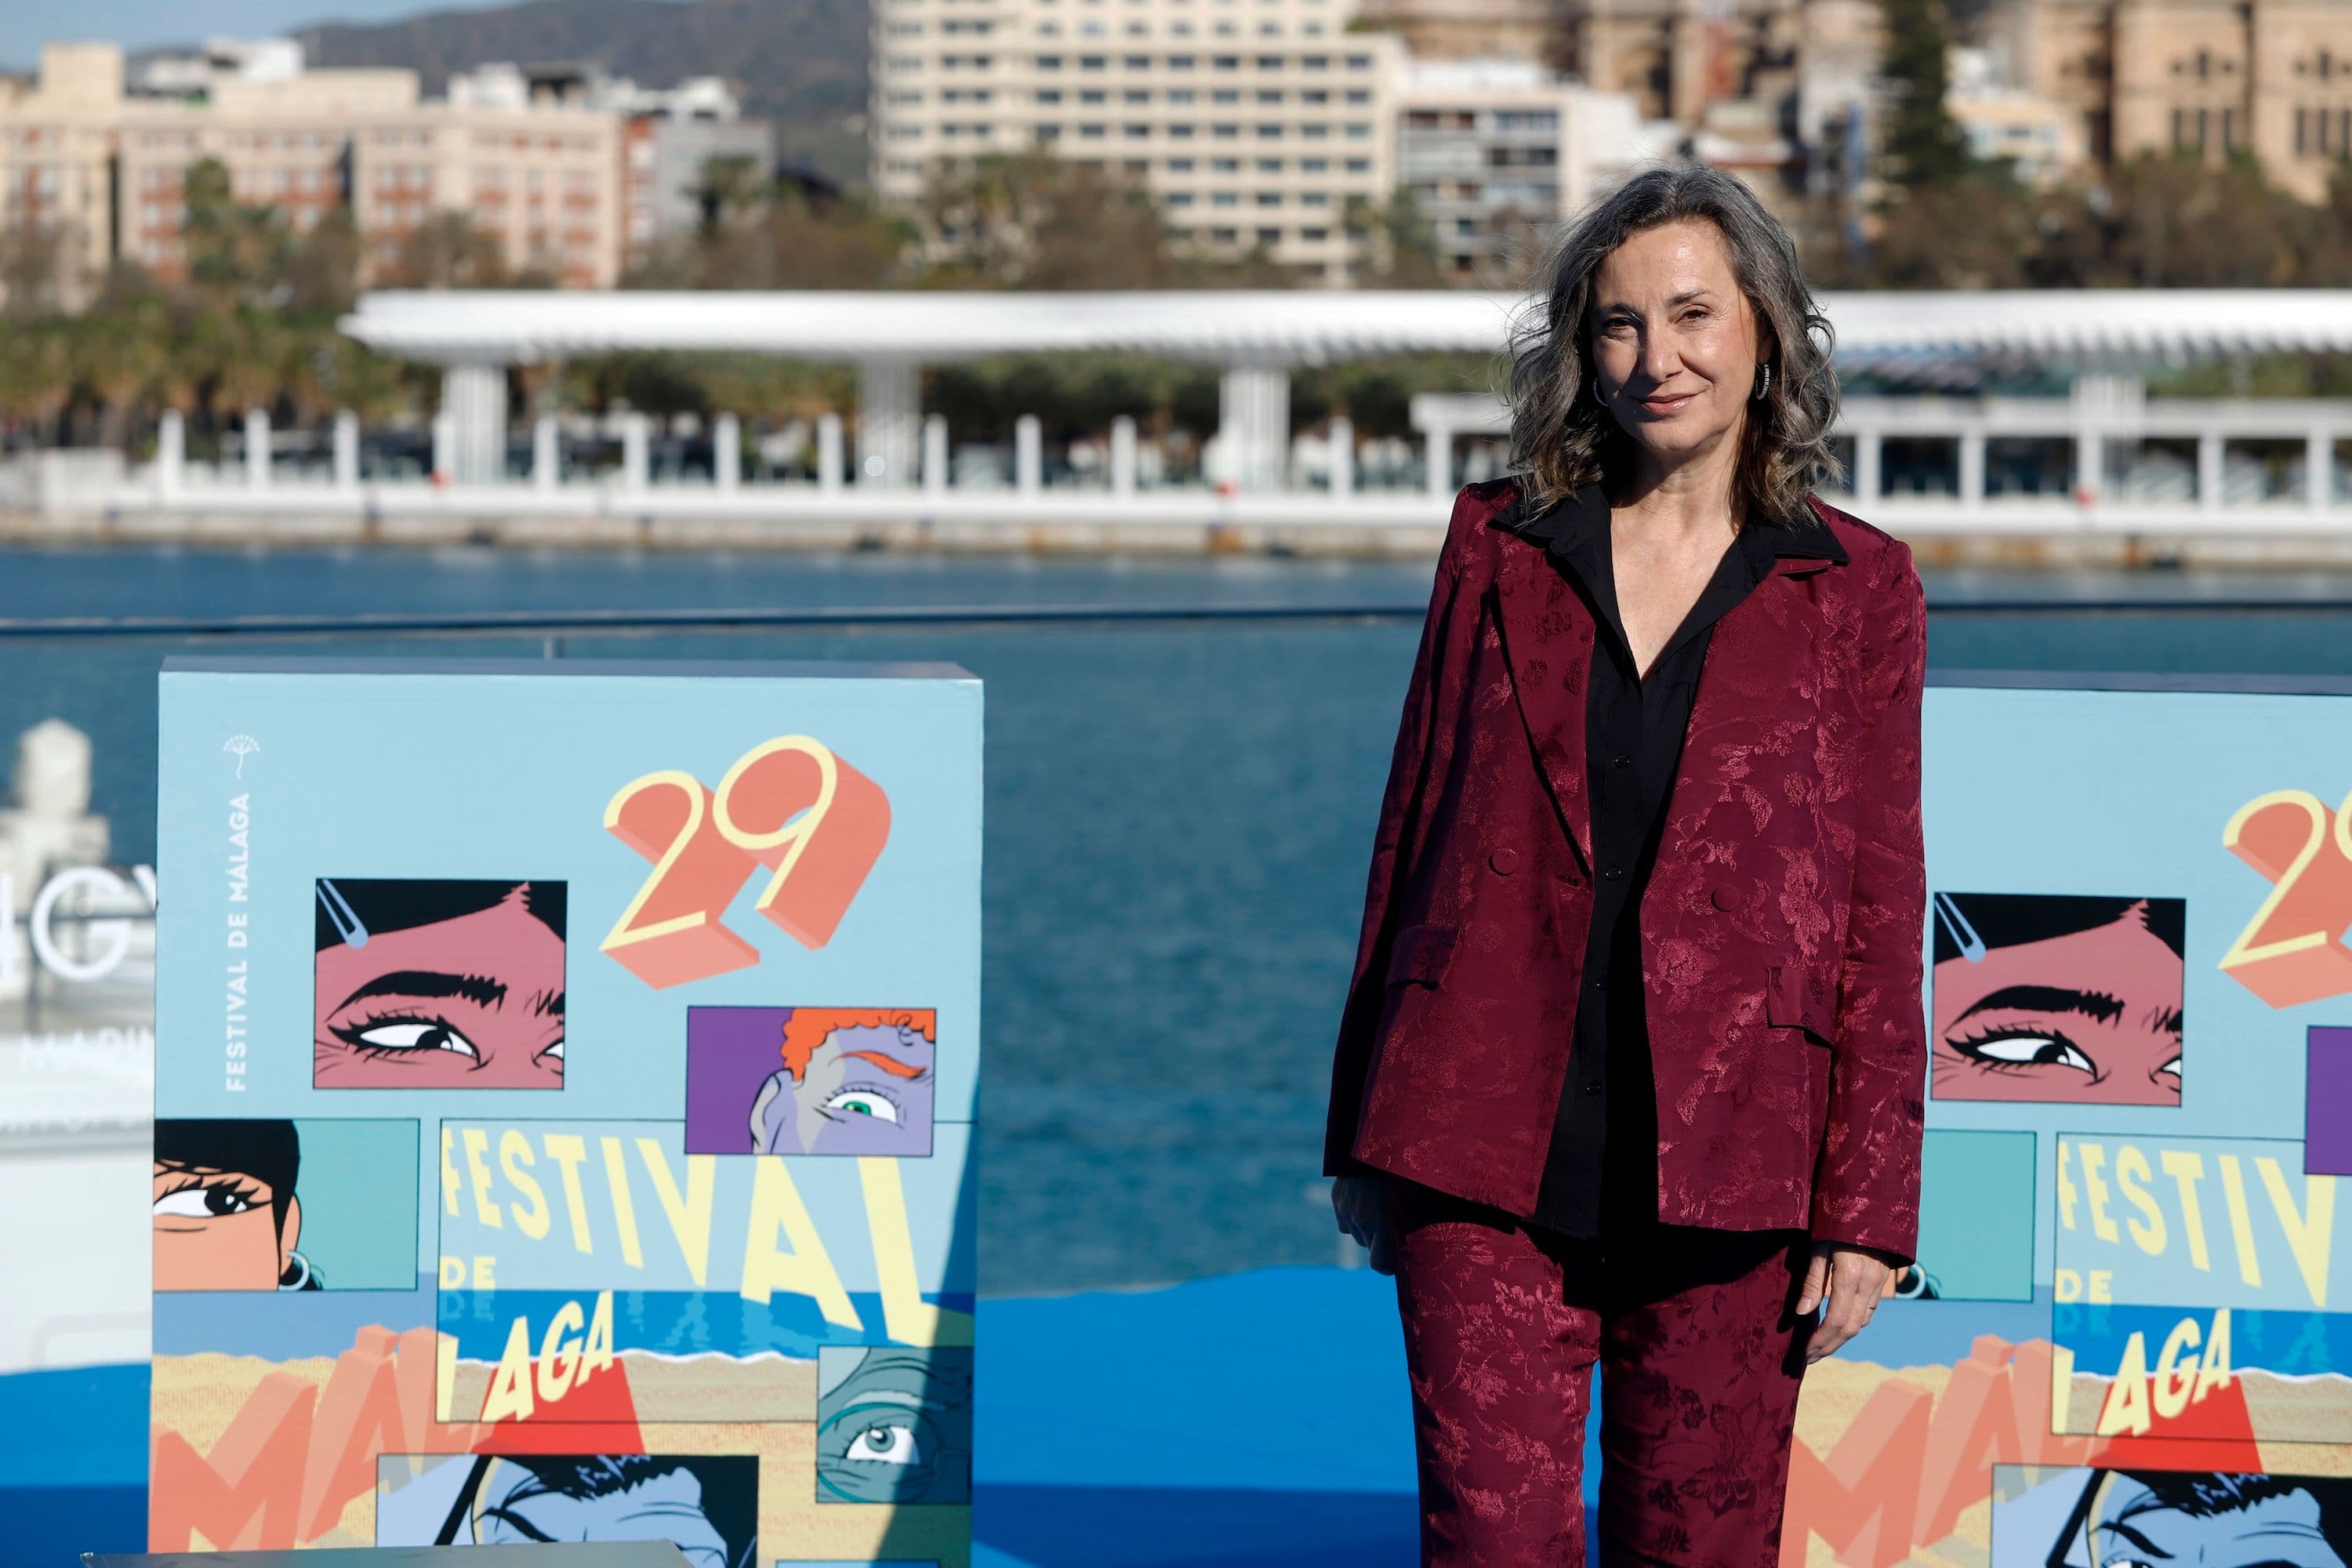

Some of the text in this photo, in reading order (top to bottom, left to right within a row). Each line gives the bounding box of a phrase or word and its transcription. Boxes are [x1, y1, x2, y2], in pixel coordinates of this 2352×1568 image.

[226, 793, 249, 1092] FESTIVAL DE MÁLAGA
[599, 734, 891, 989] 29
[2216, 789, 2352, 1010] 2
[439, 1257, 496, 1290] DE
[441, 1127, 974, 1347] FESTIVAL
[2054, 1269, 2113, 1305] DE
